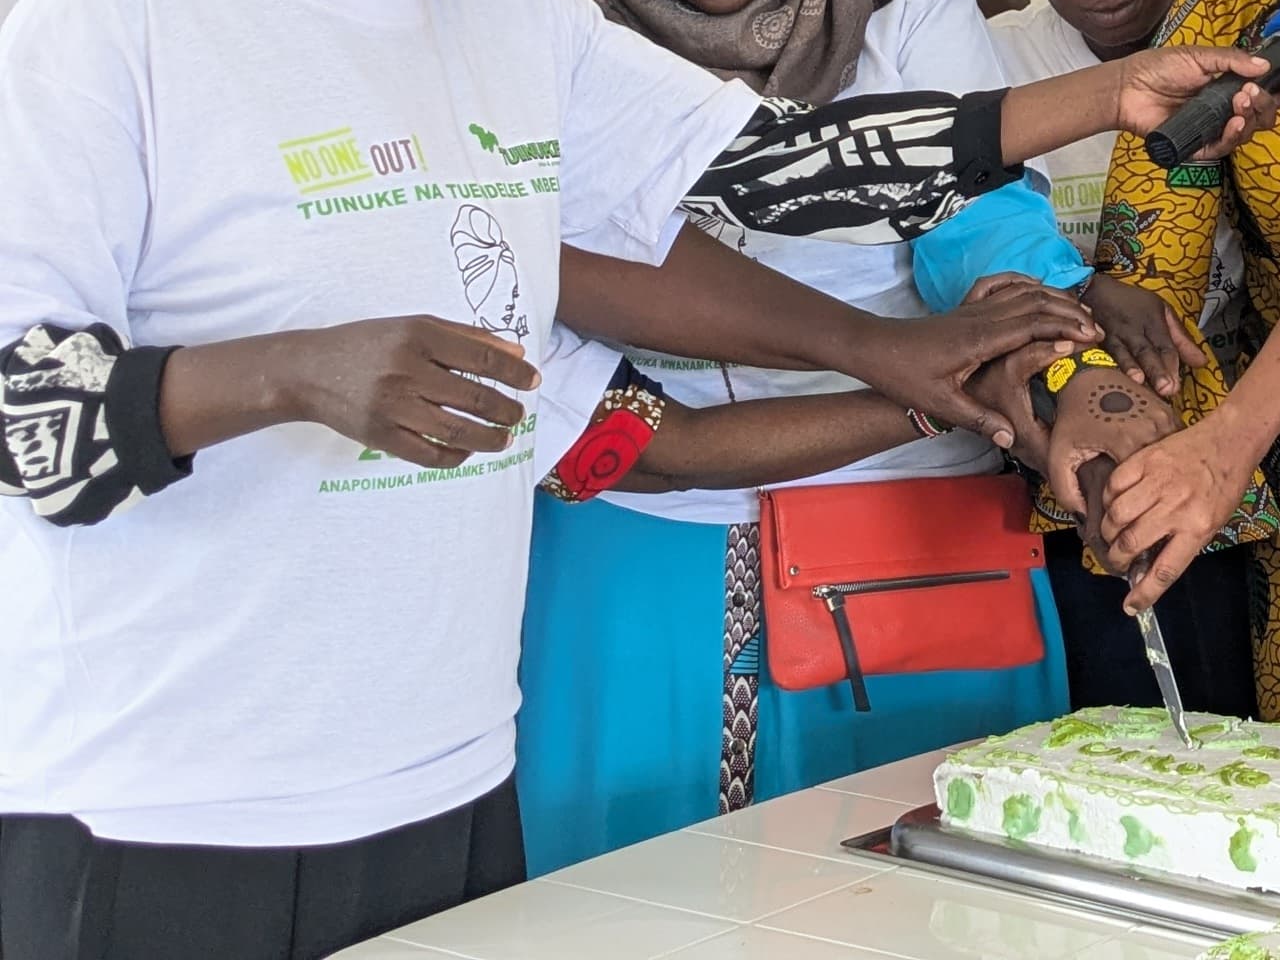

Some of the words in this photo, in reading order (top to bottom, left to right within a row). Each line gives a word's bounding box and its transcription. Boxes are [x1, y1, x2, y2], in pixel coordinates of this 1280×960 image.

[283, 149, 322, 184] NO
[318, 138, 368, 177] ONE
[297, 188, 408, 220] TUINUKE
[414, 183, 444, 202] NA
[1053, 184, 1074, 209] NO
[319, 473, 414, 494] ANAPOINUKA
[416, 463, 485, 484] MWANAMKE
